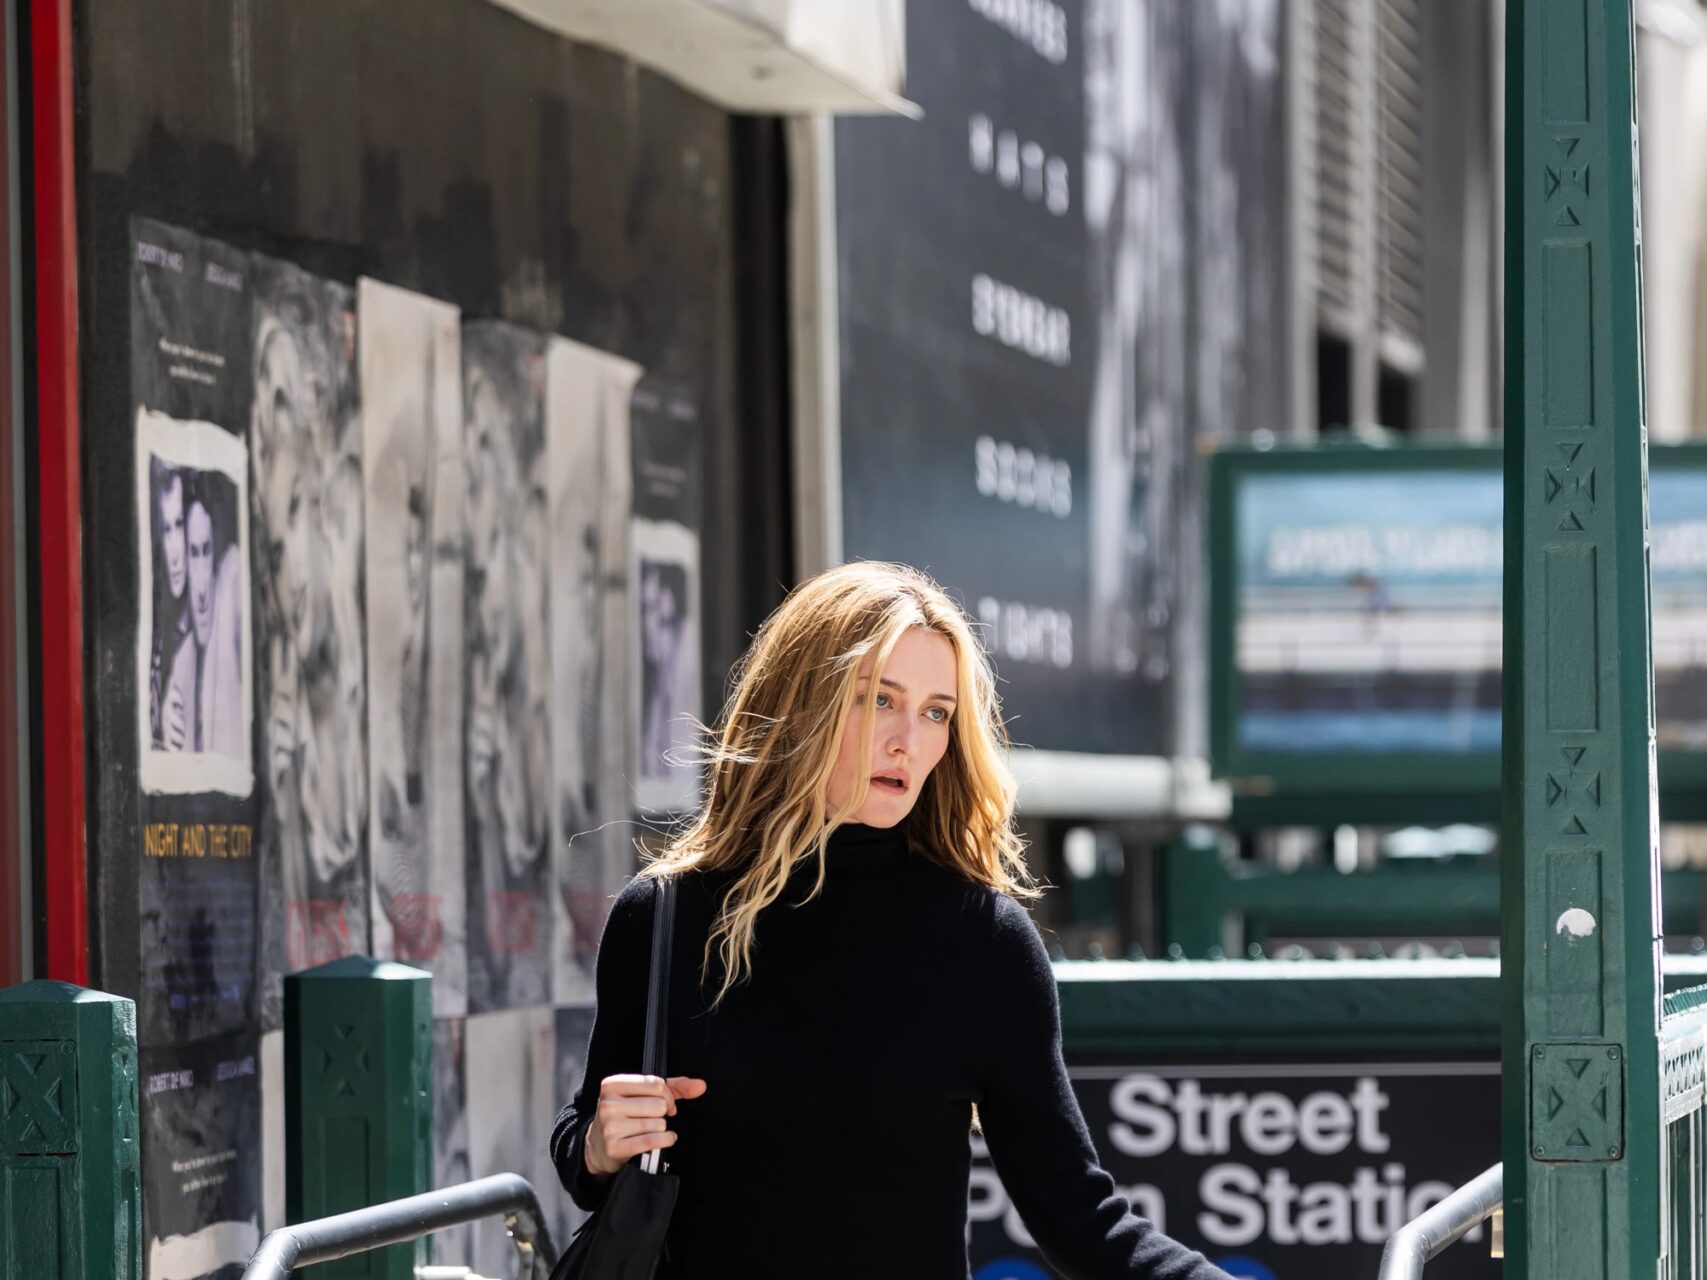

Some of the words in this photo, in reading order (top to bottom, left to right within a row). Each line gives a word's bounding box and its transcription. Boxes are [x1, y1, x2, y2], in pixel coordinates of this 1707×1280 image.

[144, 823, 179, 857] NIGHT
[182, 824, 206, 857] AND
[208, 824, 228, 857] THE
[231, 824, 253, 857] CITY
[1109, 1073, 1390, 1156] Street
[968, 1166, 1167, 1248] Pn
[1197, 1162, 1484, 1246] Stati
